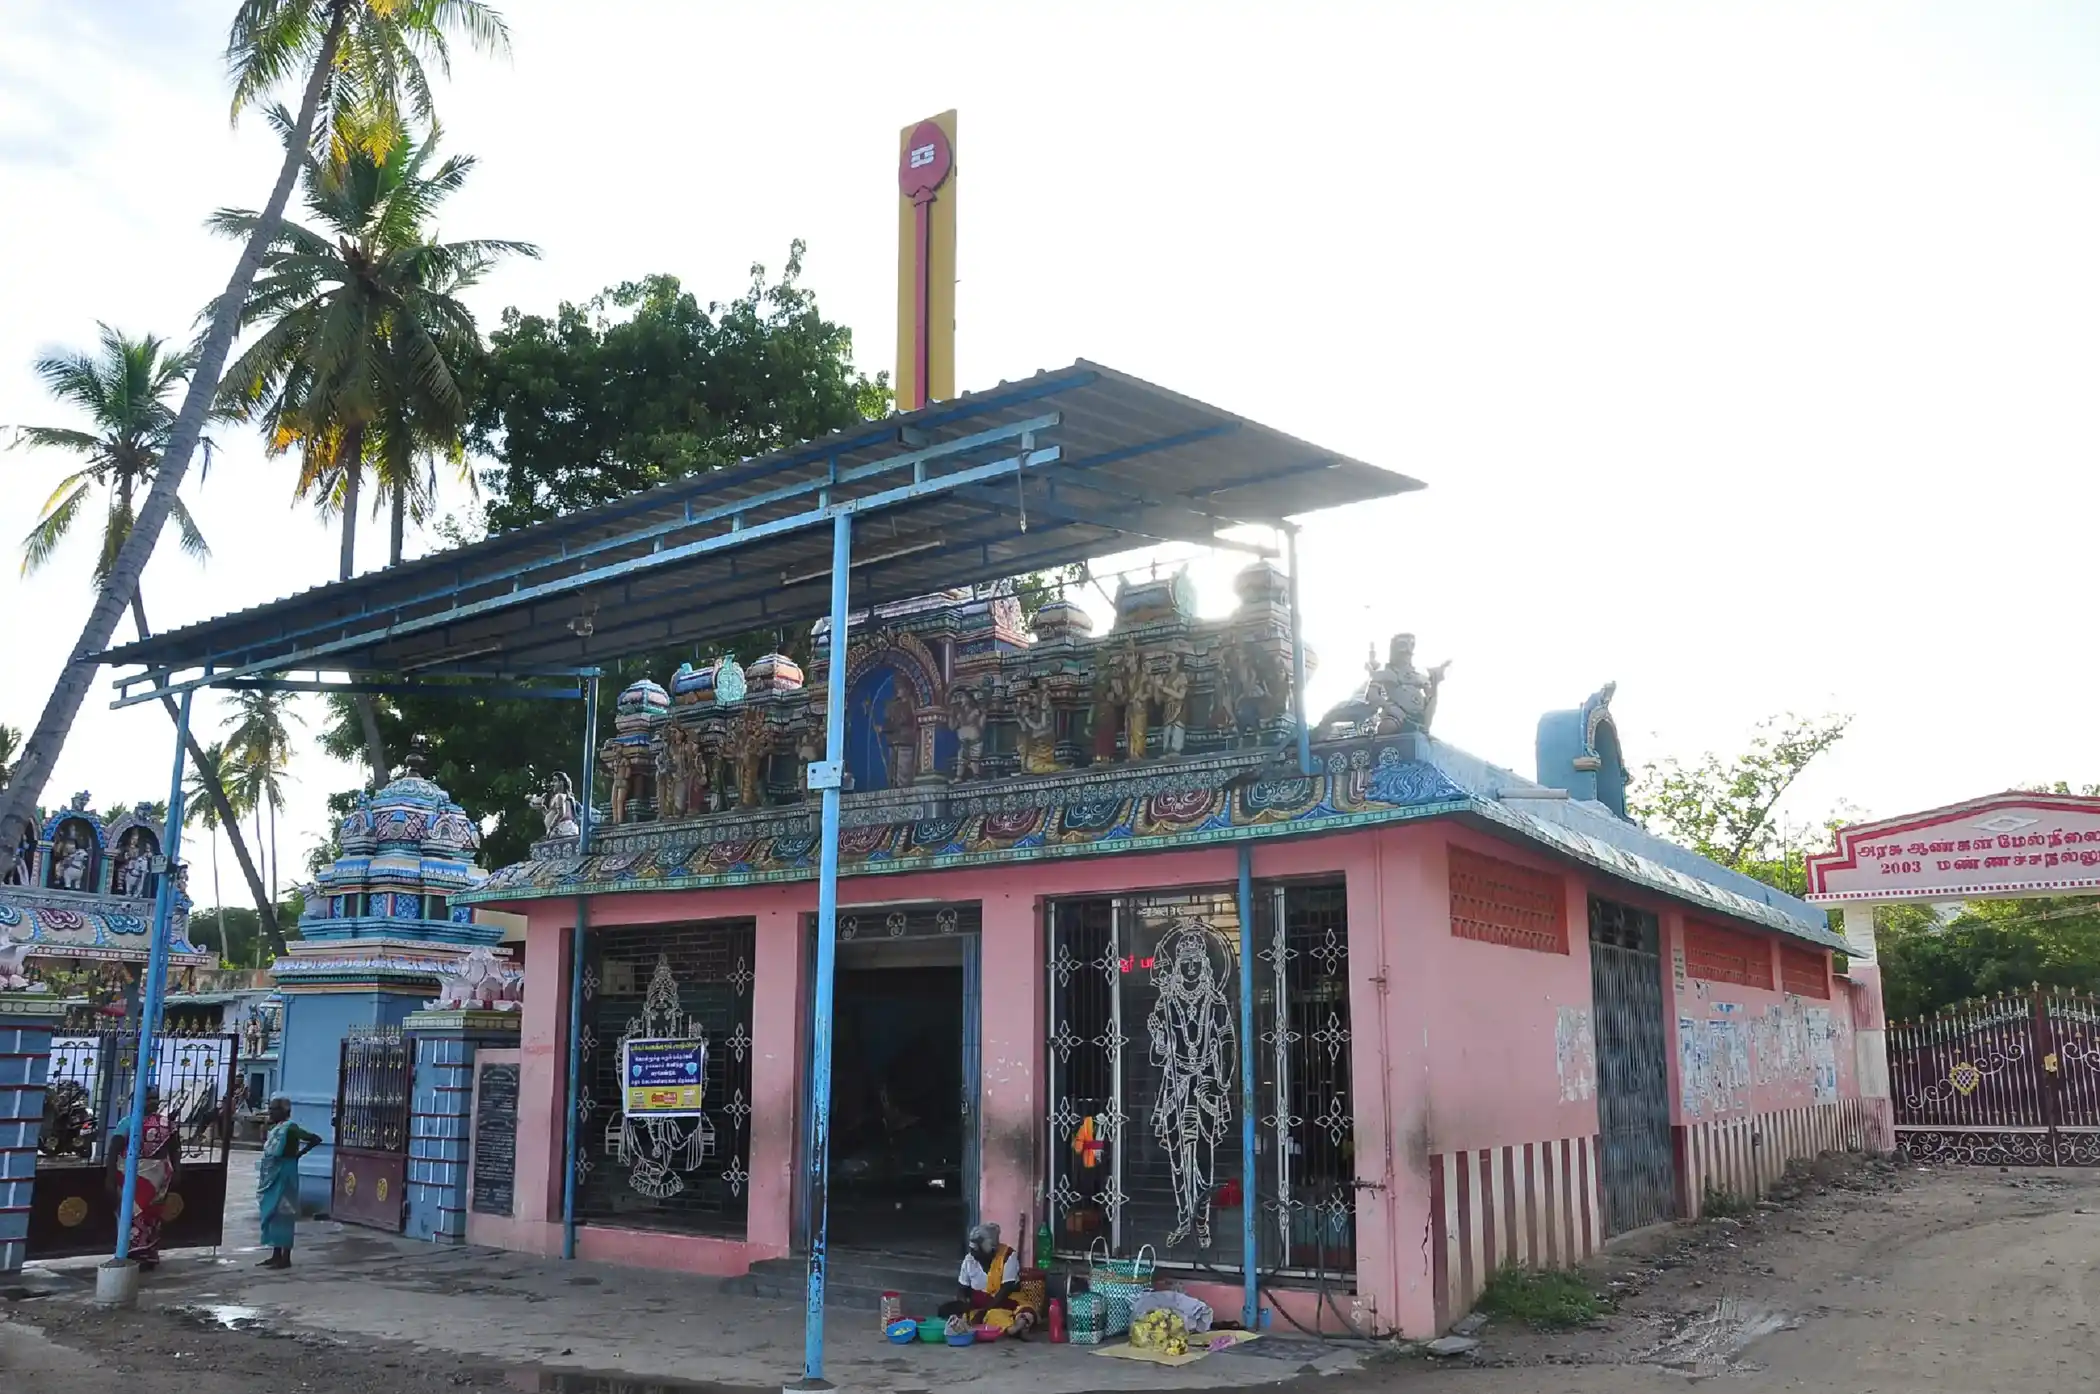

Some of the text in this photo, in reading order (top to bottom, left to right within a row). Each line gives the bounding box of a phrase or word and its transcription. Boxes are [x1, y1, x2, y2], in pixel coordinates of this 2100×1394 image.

[1857, 845, 1903, 860] அரசு
[1907, 837, 1993, 856] ஆண்கள்
[1881, 861, 1921, 874] 2003
